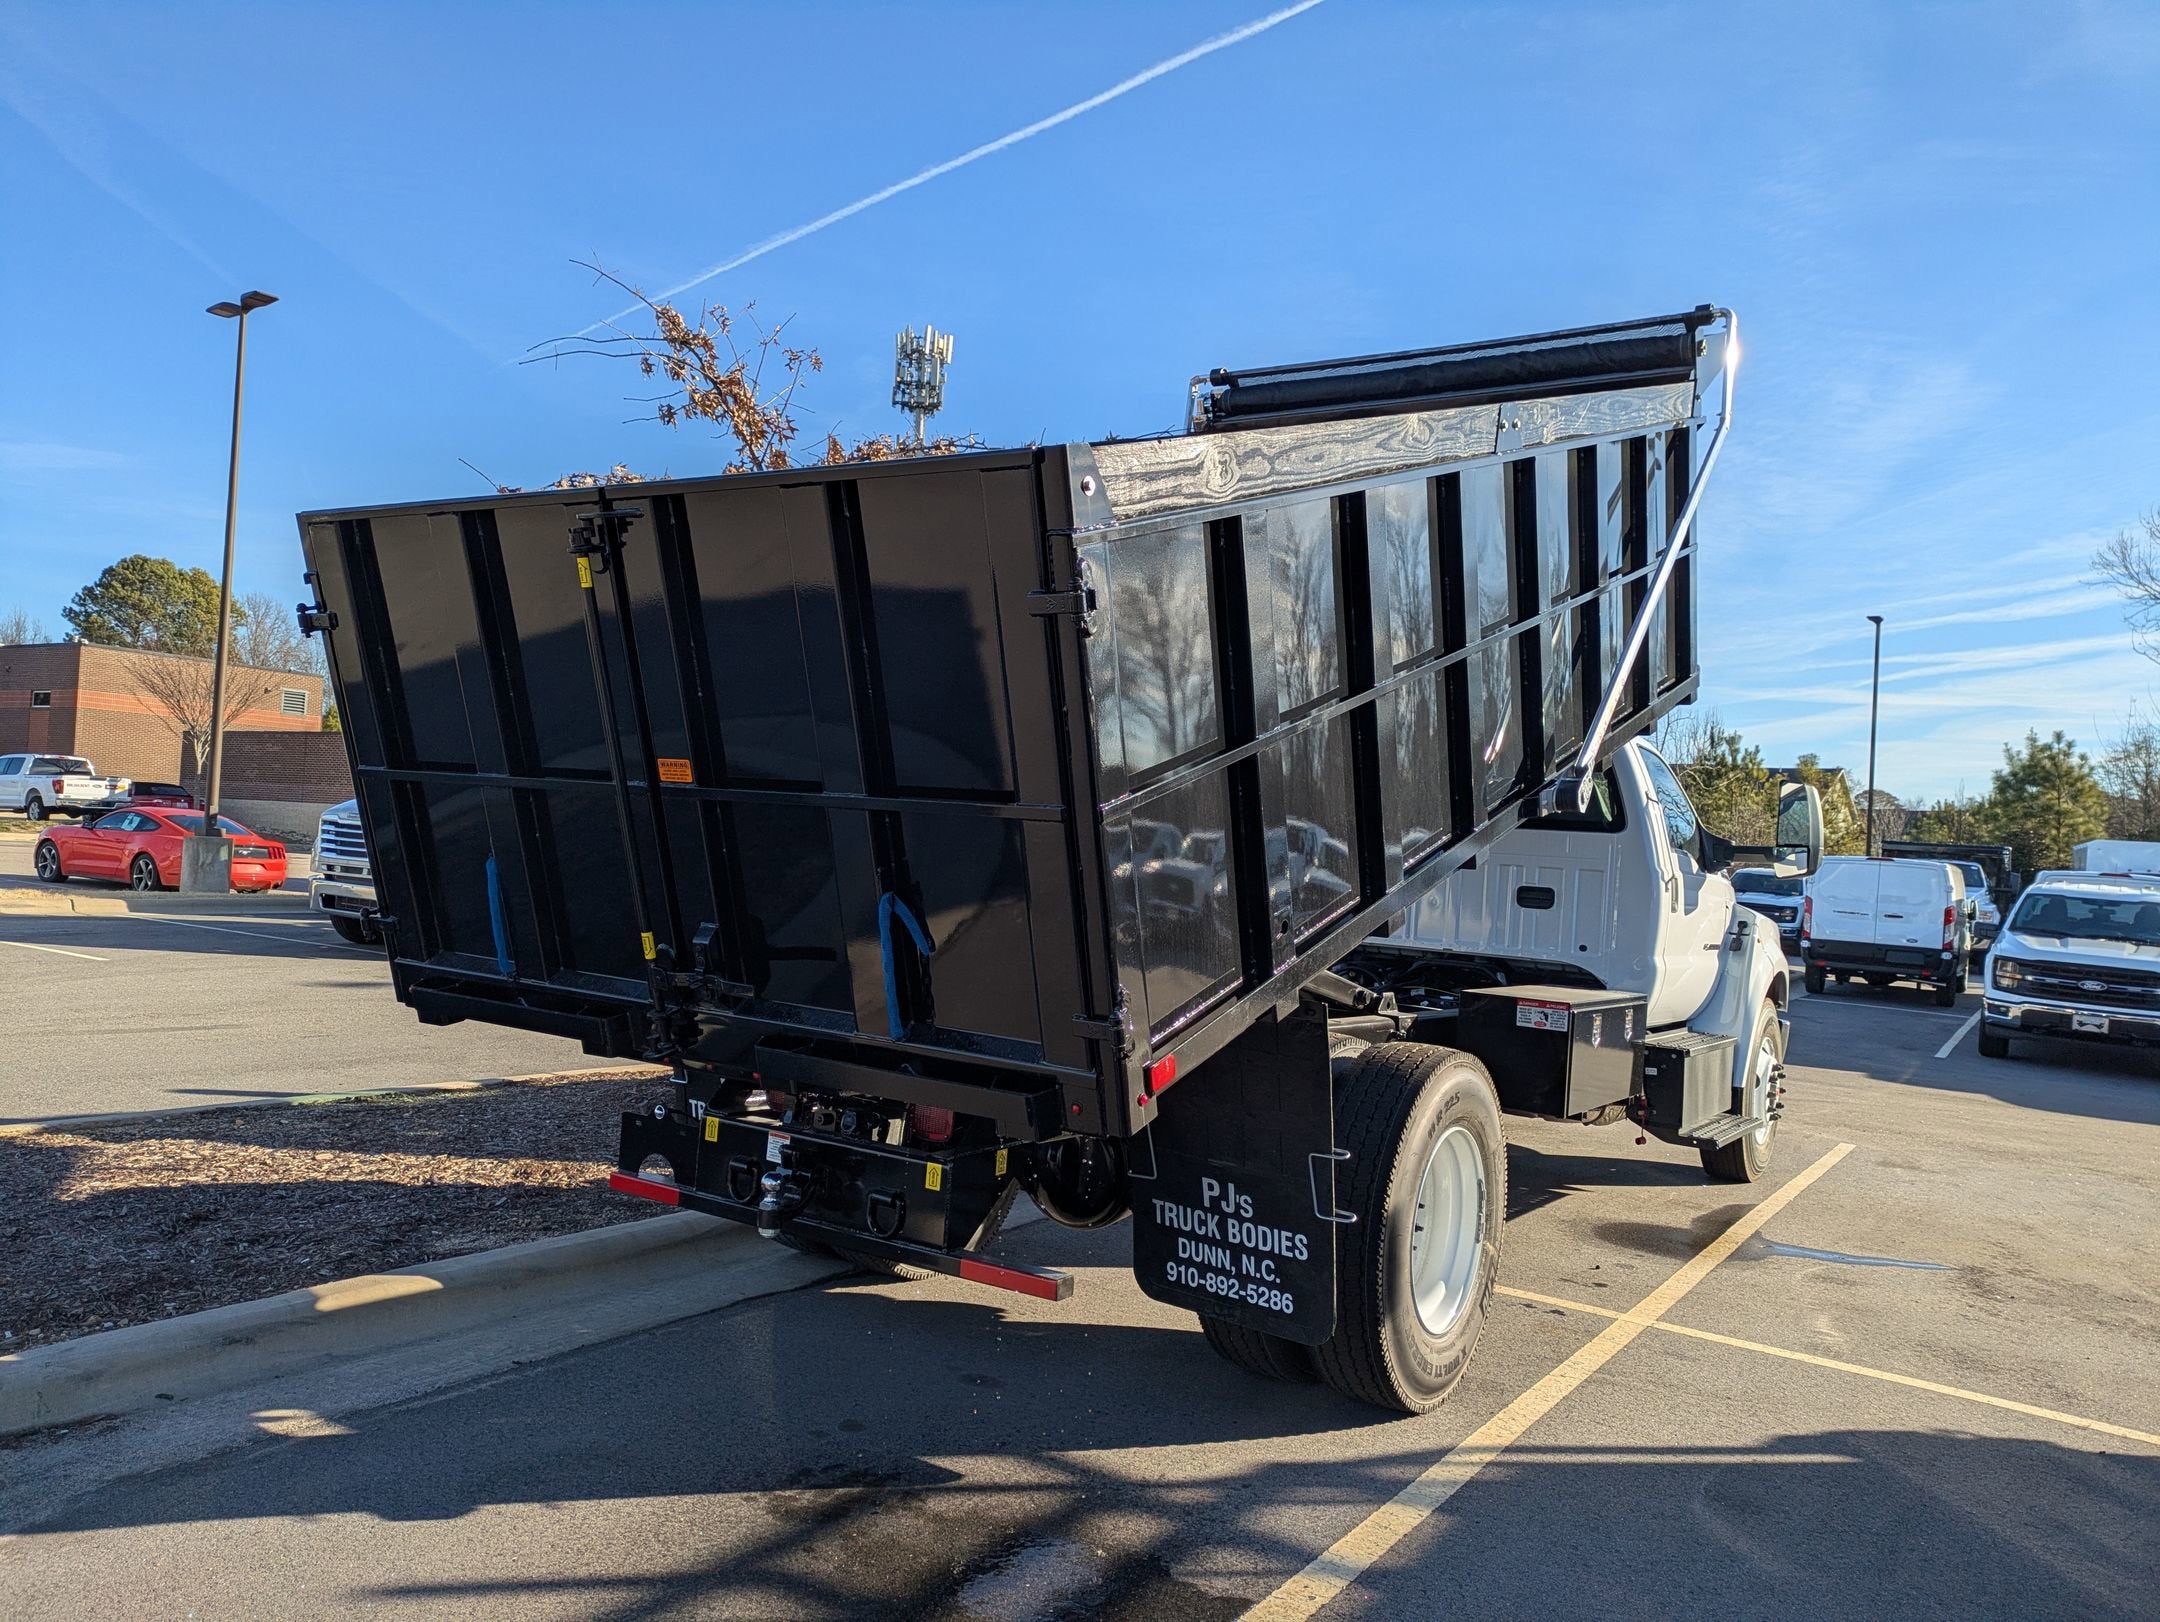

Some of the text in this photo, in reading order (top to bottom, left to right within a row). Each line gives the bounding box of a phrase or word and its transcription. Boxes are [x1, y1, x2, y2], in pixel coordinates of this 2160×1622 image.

[1151, 1198, 1309, 1261] TRUCK BODIES
[1178, 1237, 1281, 1284] DUNN, N.C.
[1166, 1261, 1294, 1315] 910-892-5286
